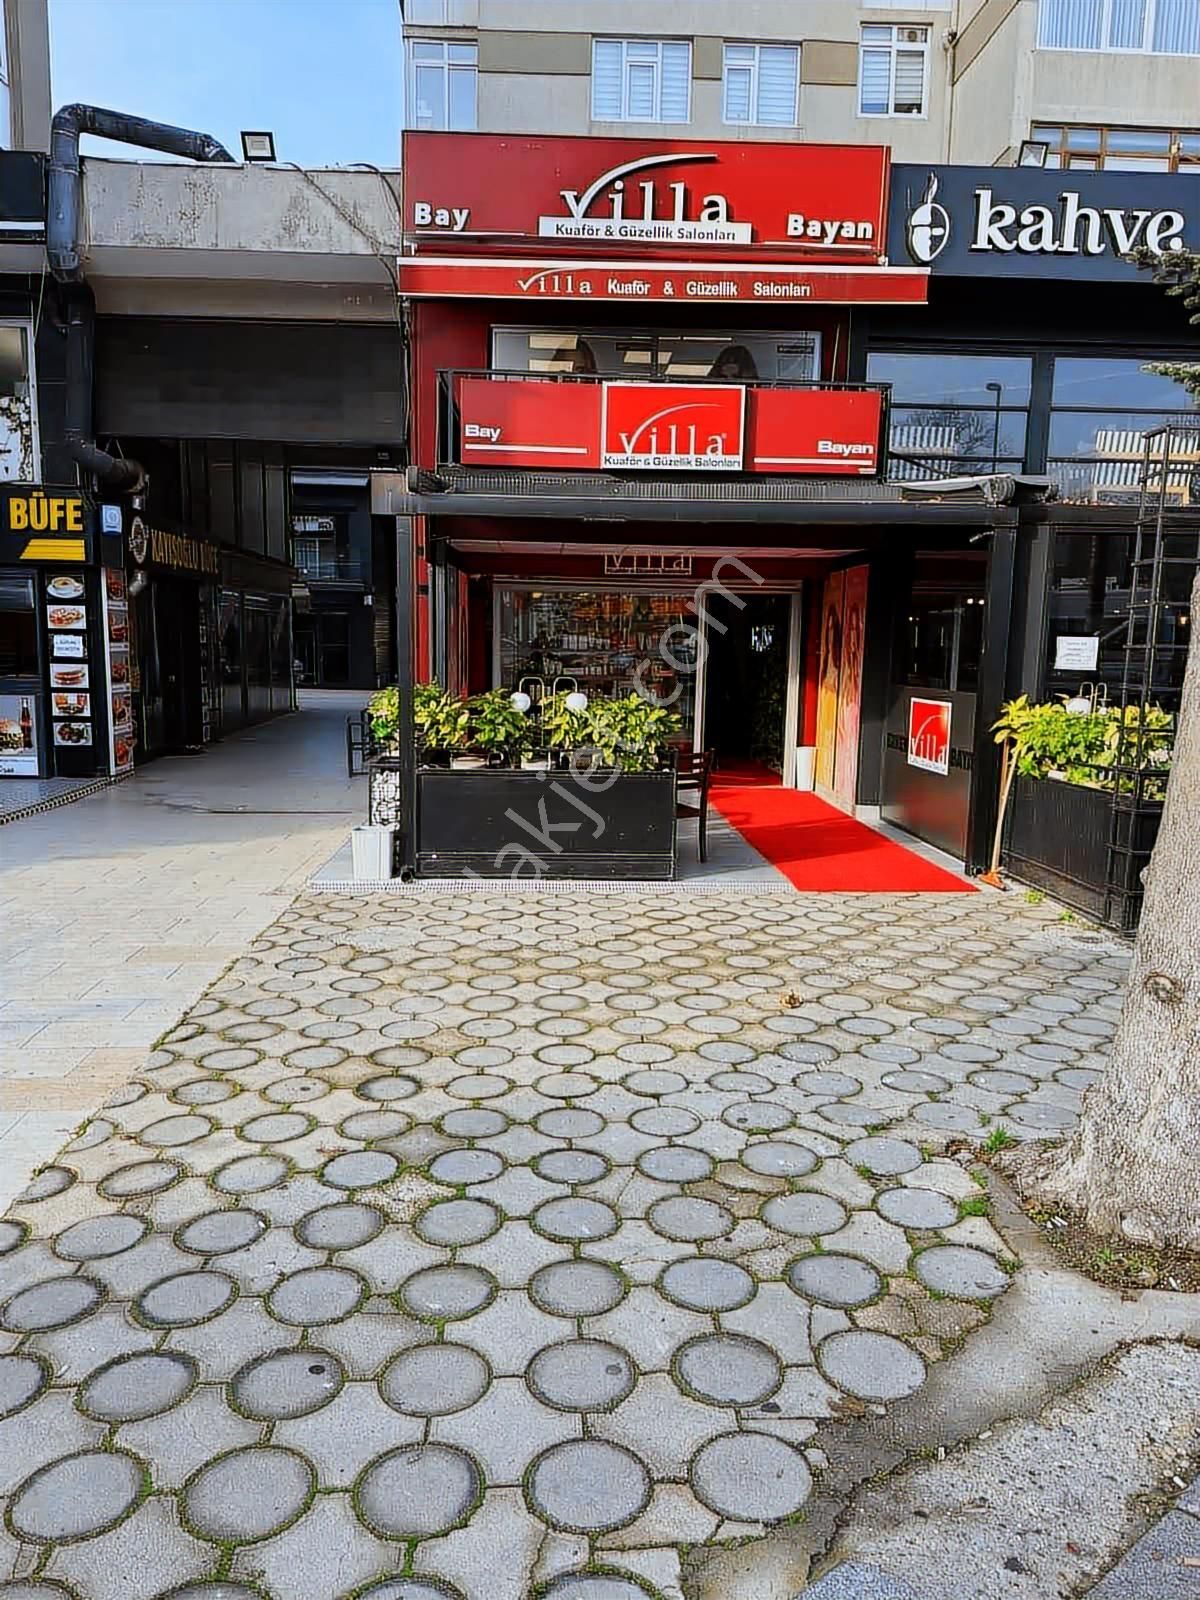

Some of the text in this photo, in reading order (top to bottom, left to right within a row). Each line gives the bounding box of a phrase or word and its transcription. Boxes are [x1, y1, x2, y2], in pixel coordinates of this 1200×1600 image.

[413, 201, 470, 231] Bay
[971, 188, 1186, 255] kahve
[555, 223, 736, 241] Kuaför & Güzellik Salonları
[786, 213, 874, 245] Bayan
[607, 279, 651, 295] Kuaför
[663, 281, 674, 295] &
[686, 281, 738, 296] Güzellik
[753, 281, 811, 297] Salonları
[464, 424, 501, 442] Bay
[817, 440, 874, 457] Bayan
[604, 455, 642, 466] Kuaför
[653, 456, 693, 467] Güzellik
[9, 491, 84, 532] BÜFE
